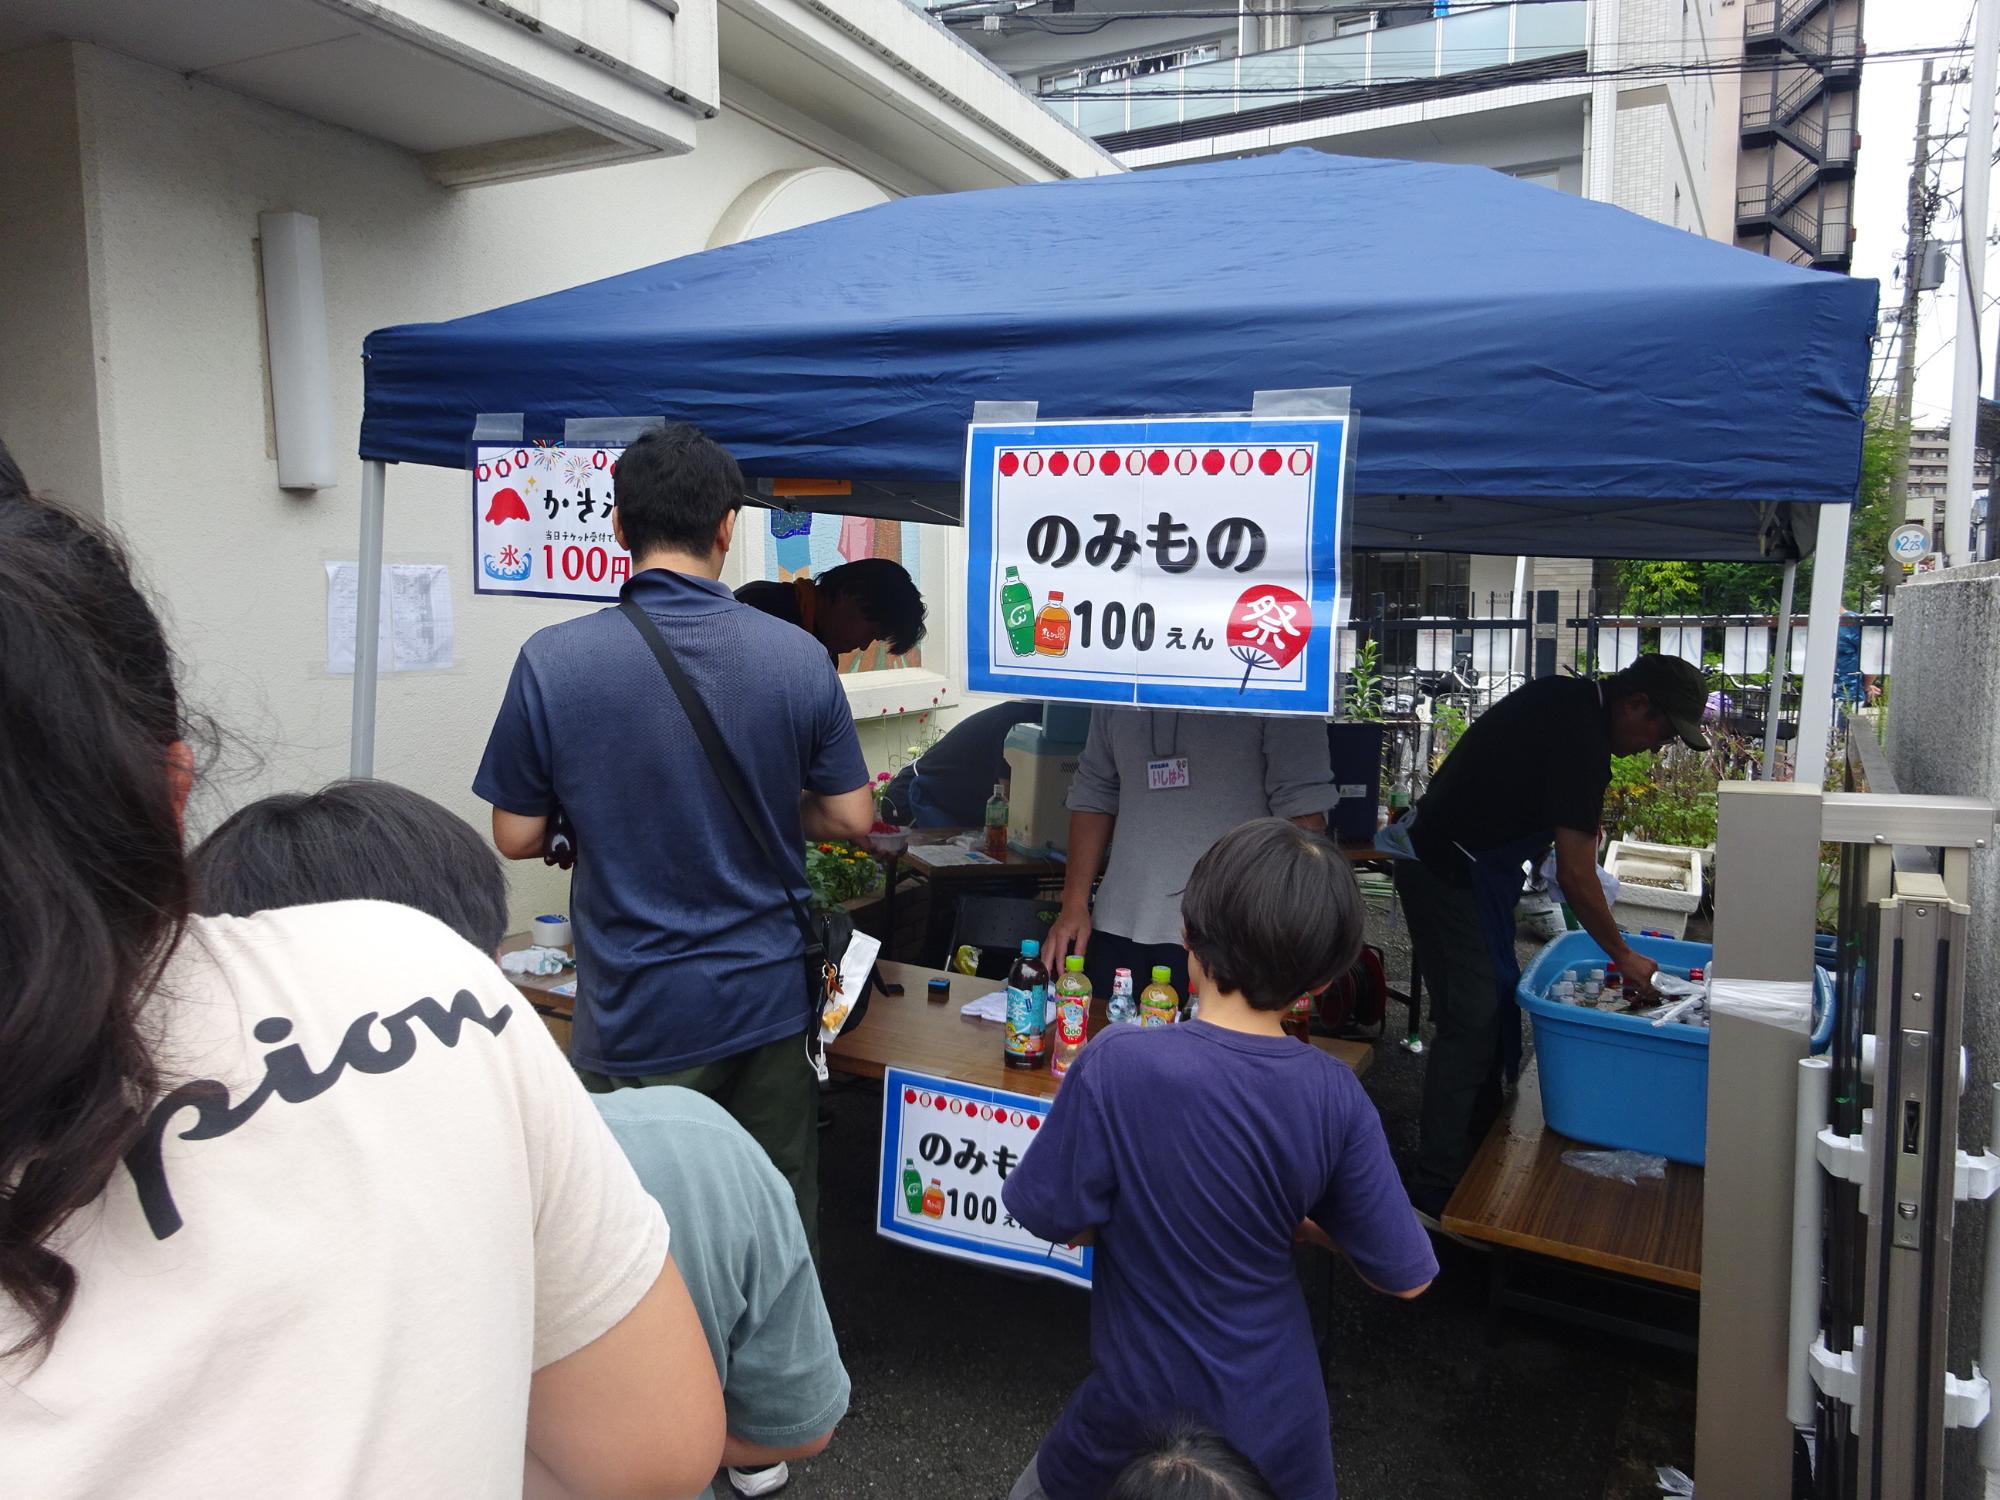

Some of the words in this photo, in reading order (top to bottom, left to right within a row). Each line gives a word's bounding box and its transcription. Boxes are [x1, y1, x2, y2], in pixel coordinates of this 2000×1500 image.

[499, 544, 521, 567] 氷
[545, 530, 617, 543] 当日チケット受付で
[1026, 511, 1268, 574] のみもの
[543, 544, 631, 583] 100円
[1239, 594, 1303, 651] 祭
[1064, 1026, 1081, 1036] Qoo
[946, 1188, 1023, 1229] 100え
